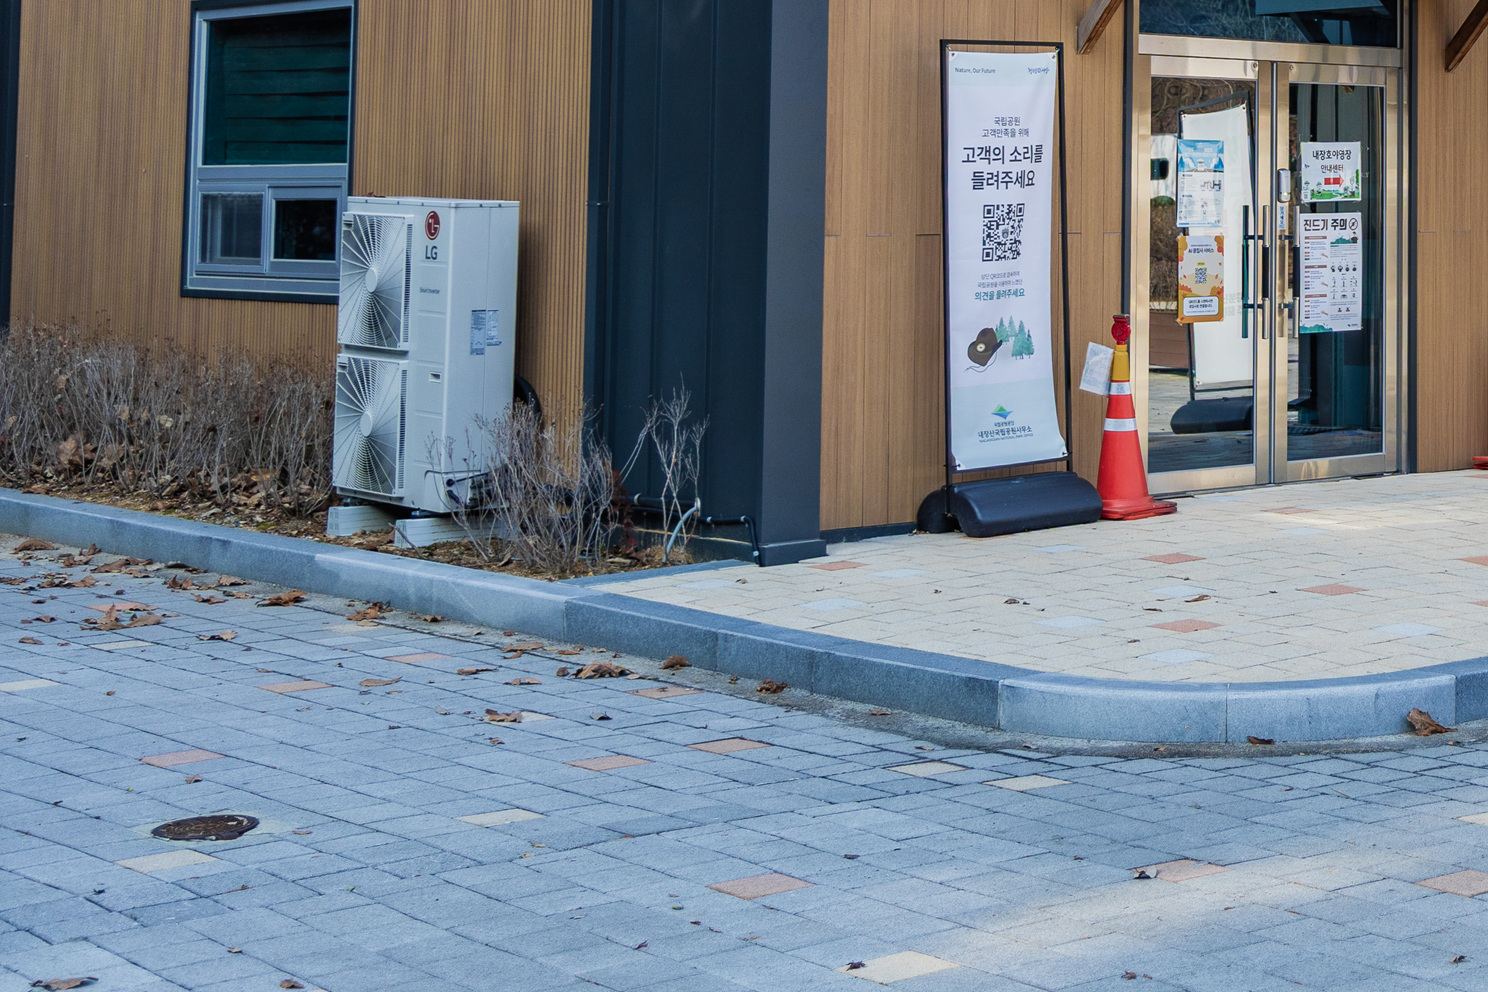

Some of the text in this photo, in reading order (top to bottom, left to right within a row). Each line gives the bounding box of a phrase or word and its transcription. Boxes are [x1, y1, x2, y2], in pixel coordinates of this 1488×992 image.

[994, 116, 1021, 127] 국립공원
[982, 128, 1029, 138] 고객만족을 위해
[961, 144, 1043, 165] 고객의 소리를
[1312, 149, 1352, 161] 내장호야영장
[1320, 164, 1344, 174] 안내센터
[971, 169, 1035, 190] 들려주세요
[1303, 218, 1348, 231] 진드기 주의
[425, 245, 438, 260] LG
[974, 288, 1025, 301] 의견을 들려주세요
[977, 425, 1033, 439] 내장산국립공원사무소
